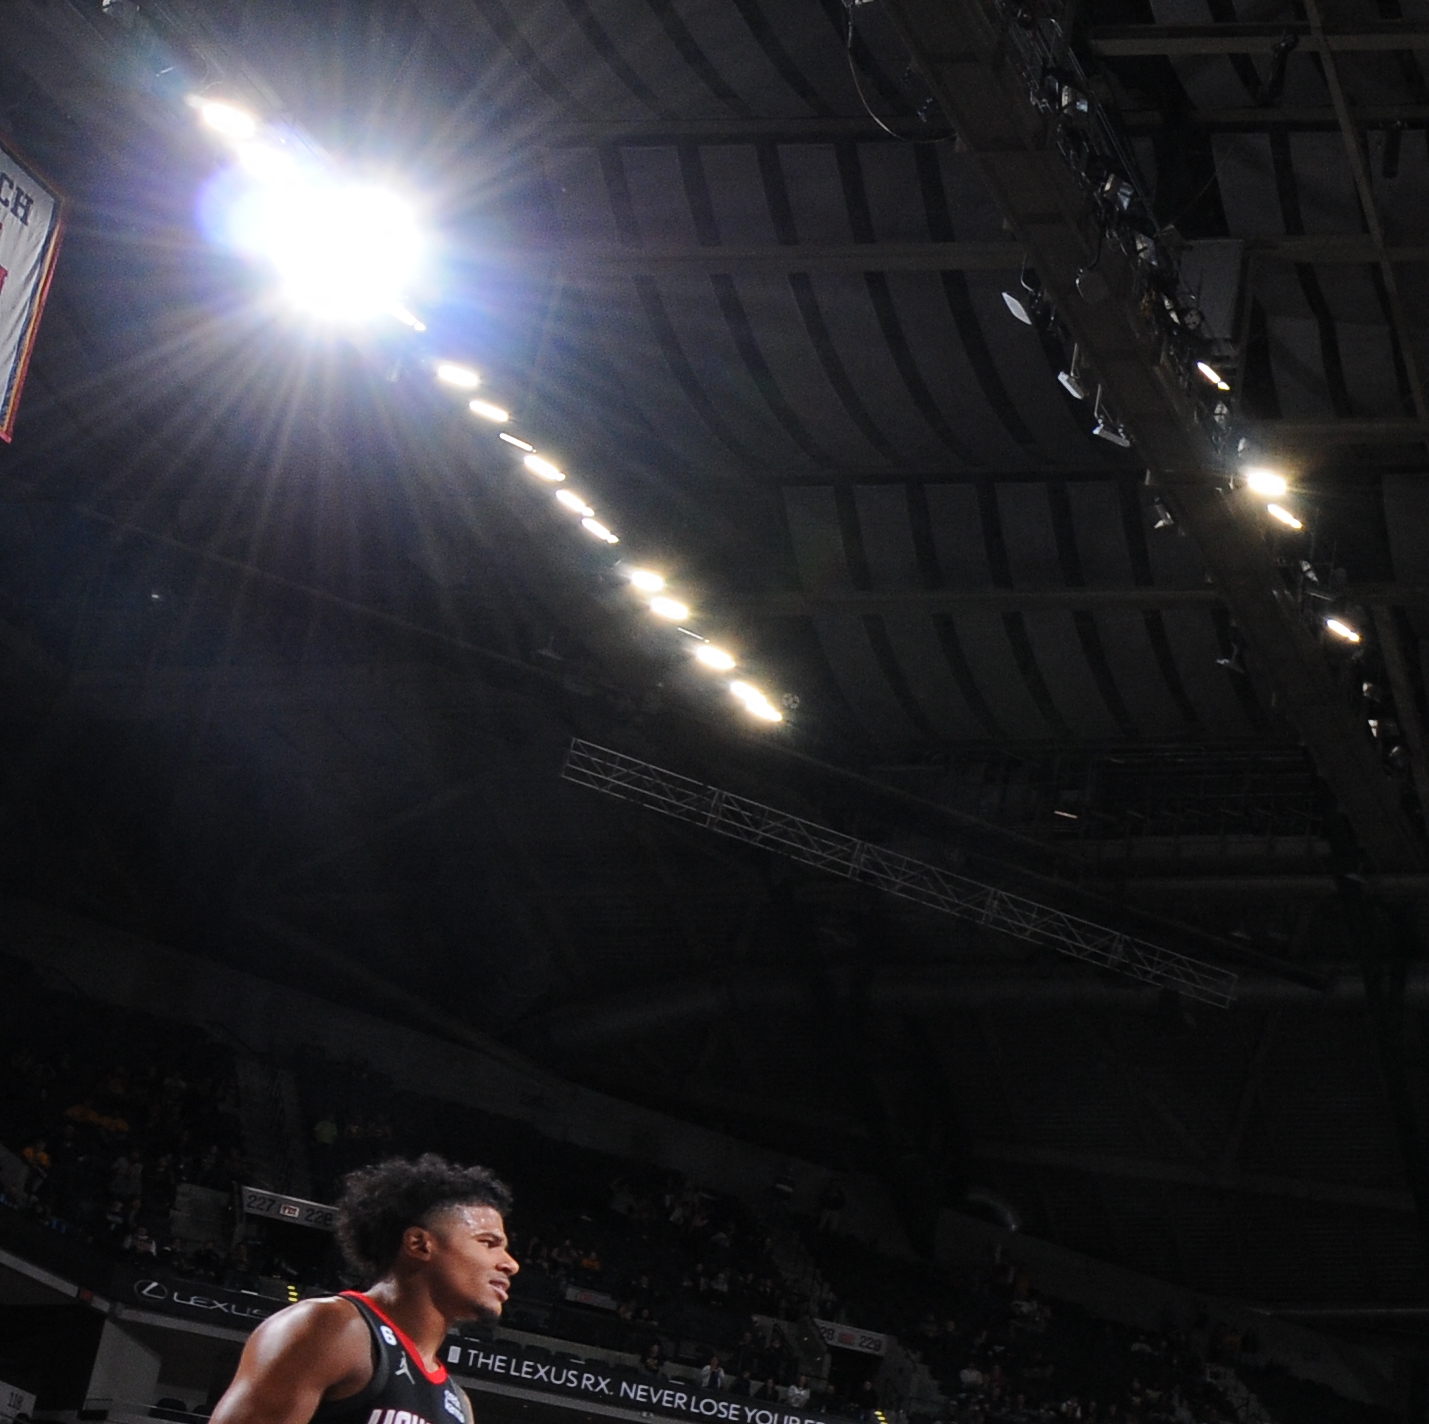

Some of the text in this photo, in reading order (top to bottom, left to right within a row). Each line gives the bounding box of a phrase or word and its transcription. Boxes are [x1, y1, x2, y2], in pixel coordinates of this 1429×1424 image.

[468, 1349, 507, 1374] THE
[510, 1354, 578, 1388] LEXUS
[620, 1381, 687, 1410] NEVER
[690, 1396, 740, 1422] LOSE
